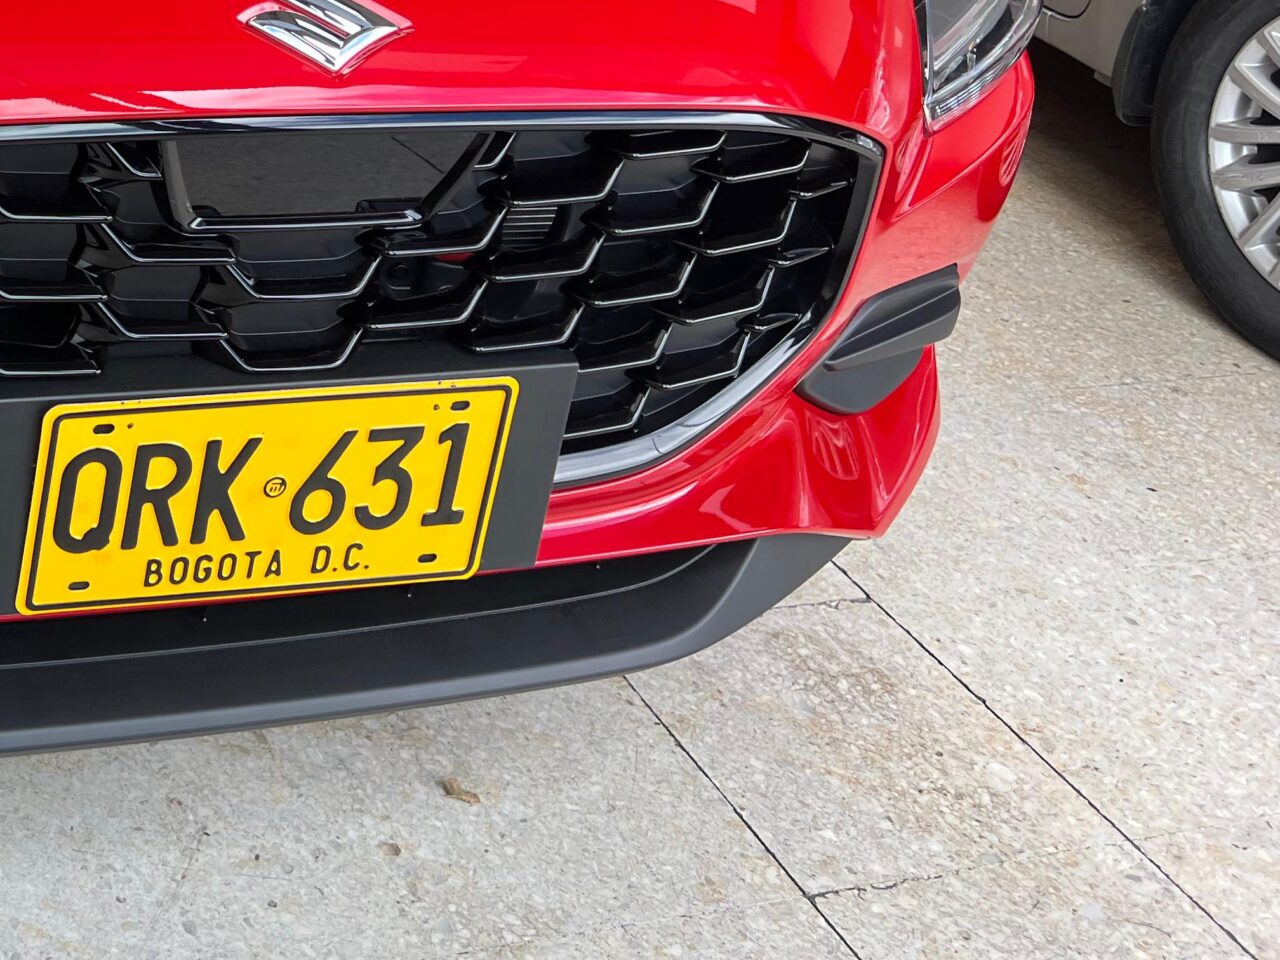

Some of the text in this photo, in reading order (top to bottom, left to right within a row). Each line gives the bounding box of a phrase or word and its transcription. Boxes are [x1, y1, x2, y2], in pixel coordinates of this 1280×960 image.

[53, 422, 470, 554] QRK 631
[144, 543, 370, 587] BOGOTA D.C.
